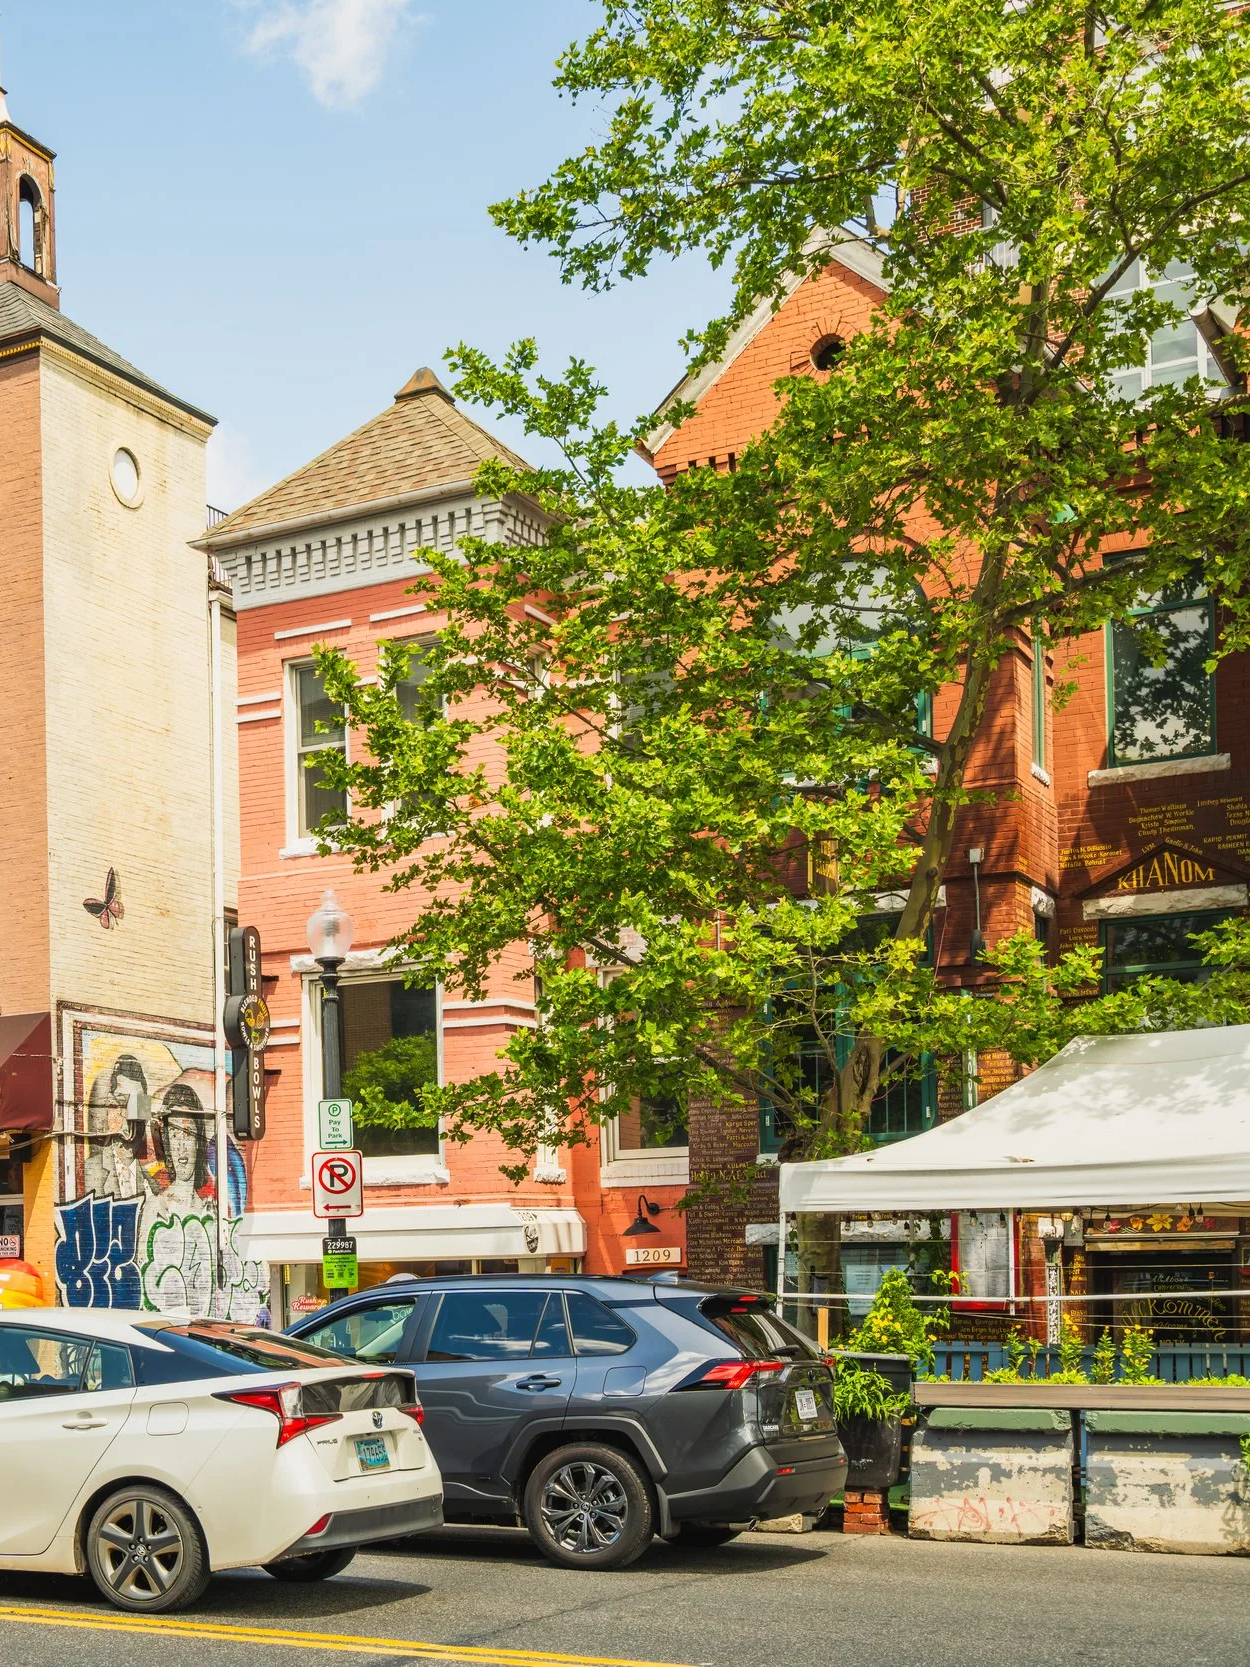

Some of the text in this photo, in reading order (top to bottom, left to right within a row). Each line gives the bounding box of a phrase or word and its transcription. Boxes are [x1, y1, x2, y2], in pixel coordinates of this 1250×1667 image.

[1117, 851, 1216, 890] KHANOM
[249, 935, 257, 991] RUSH
[252, 1057, 262, 1128] BOWLS
[327, 1241, 353, 1249] 229987
[634, 1249, 671, 1263] 1209
[298, 1295, 317, 1304] Rush
